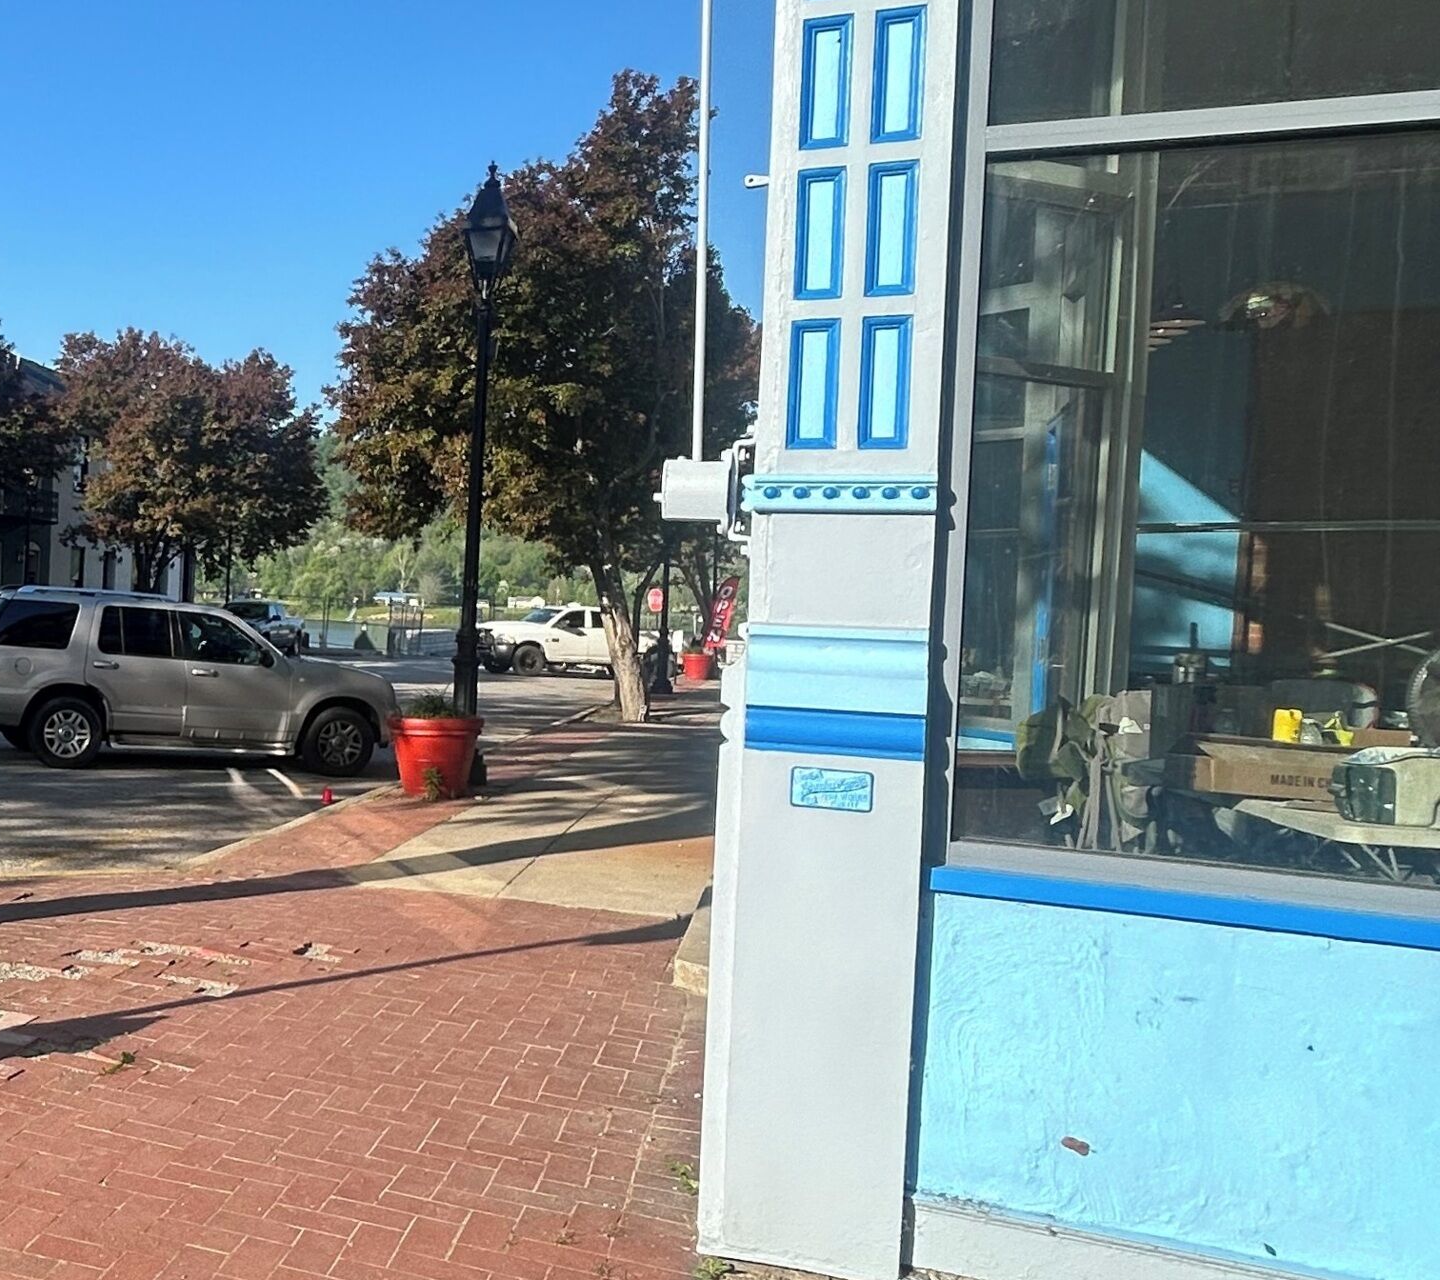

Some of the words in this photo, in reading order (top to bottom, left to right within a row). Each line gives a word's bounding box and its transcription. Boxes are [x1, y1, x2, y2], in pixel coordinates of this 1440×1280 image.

[707, 586, 733, 642] OPEN
[1271, 774, 1301, 787] MADE
[1303, 776, 1315, 787] IN
